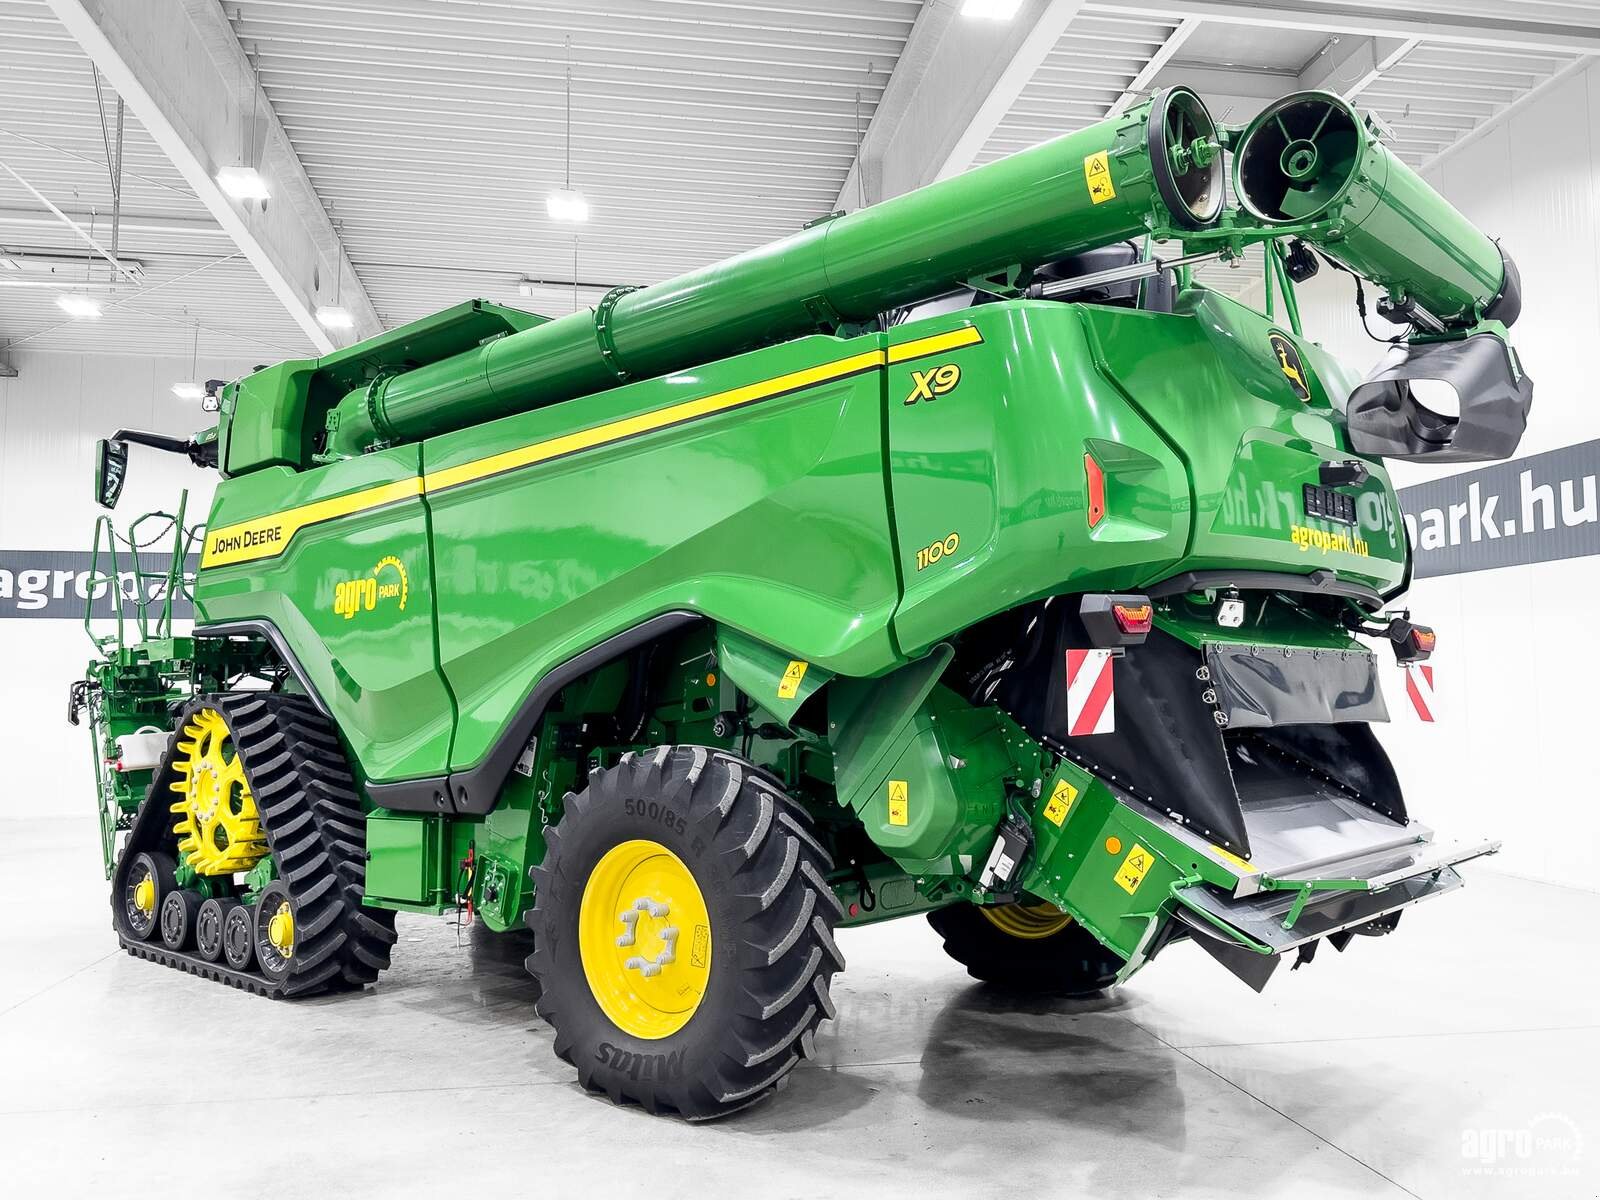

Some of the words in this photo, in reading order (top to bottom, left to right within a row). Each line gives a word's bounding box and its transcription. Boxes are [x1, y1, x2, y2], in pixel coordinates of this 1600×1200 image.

[904, 363, 962, 405] X9
[212, 535, 242, 555] JOHN
[243, 526, 282, 548] DEERE
[916, 532, 960, 571] 1100
[1290, 523, 1369, 558] agropark.hu
[333, 577, 378, 620] agro
[378, 583, 401, 599] PARK
[624, 799, 688, 836] 500/85
